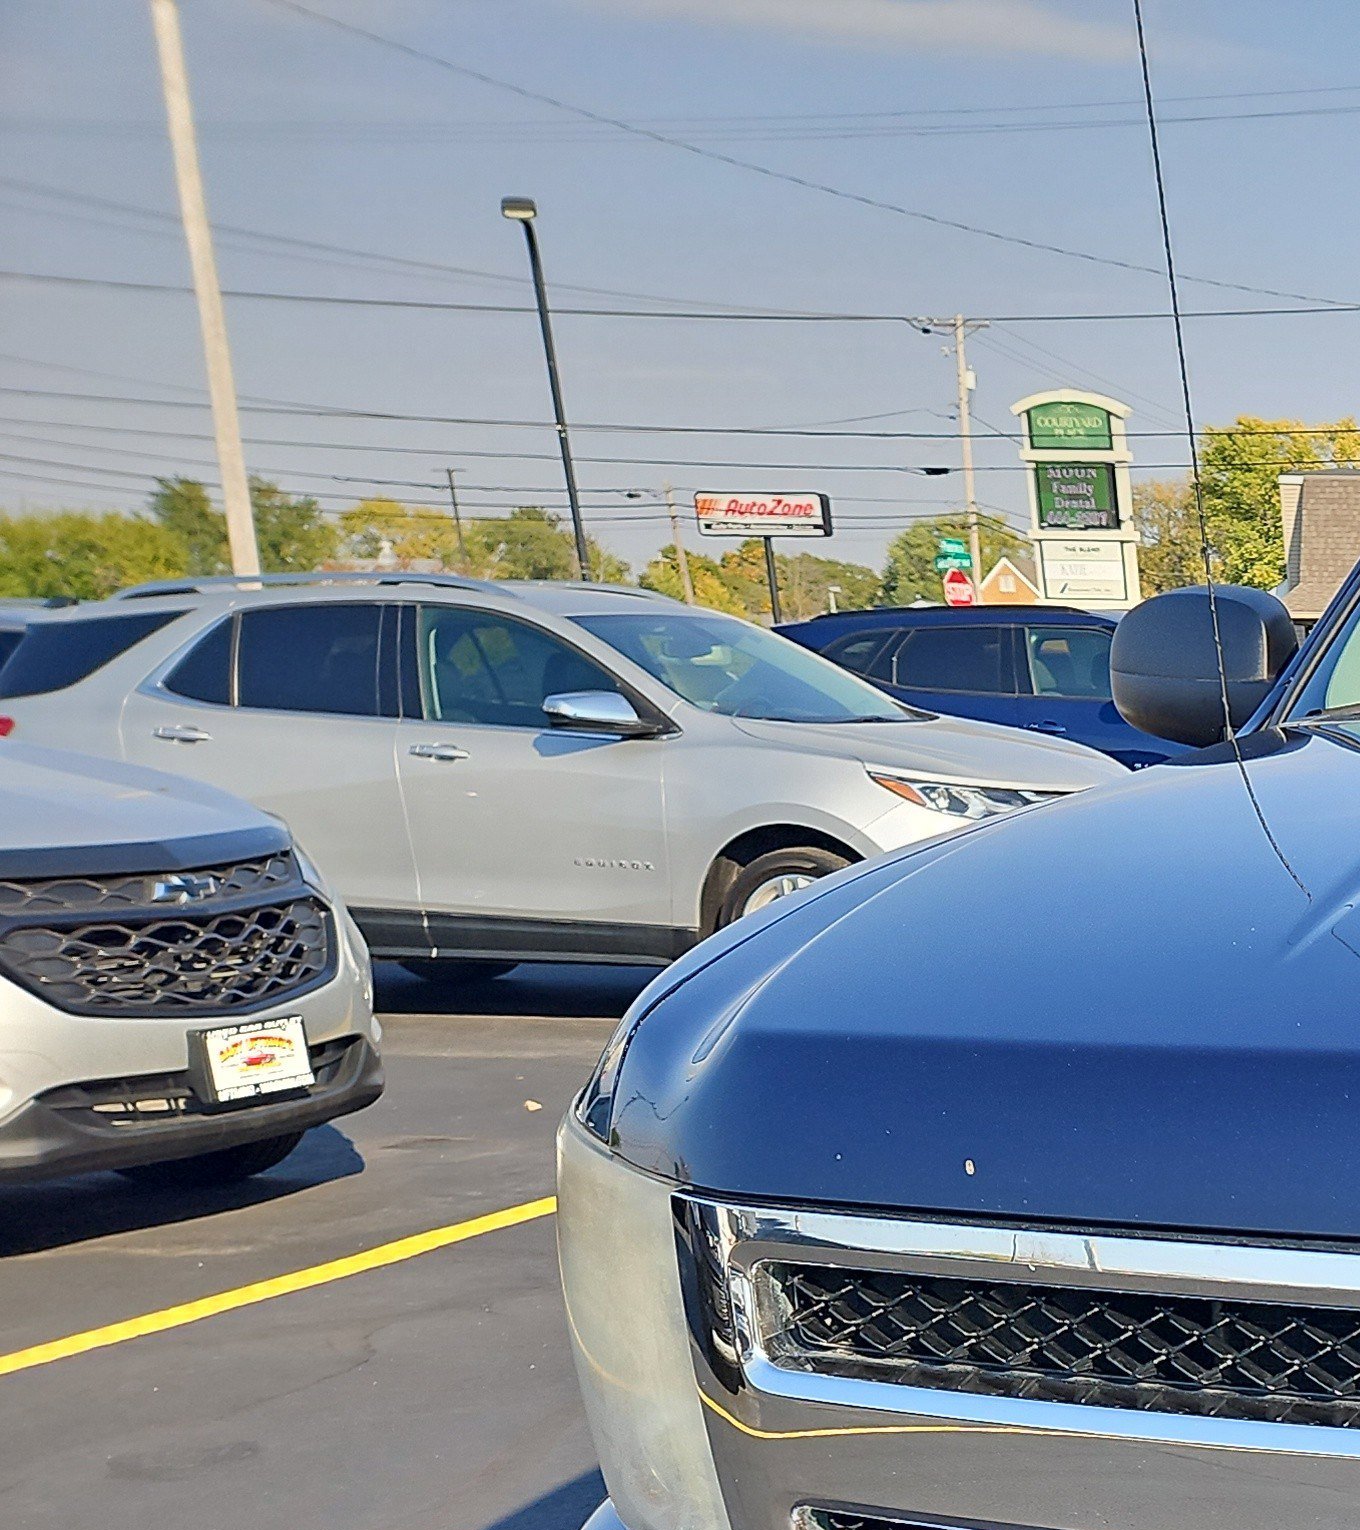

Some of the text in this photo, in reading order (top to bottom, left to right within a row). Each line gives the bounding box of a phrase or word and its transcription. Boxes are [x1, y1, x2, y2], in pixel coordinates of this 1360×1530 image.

[1051, 481, 1095, 496] Family
[724, 498, 814, 517] AutoZone
[1054, 496, 1096, 509] Dental
